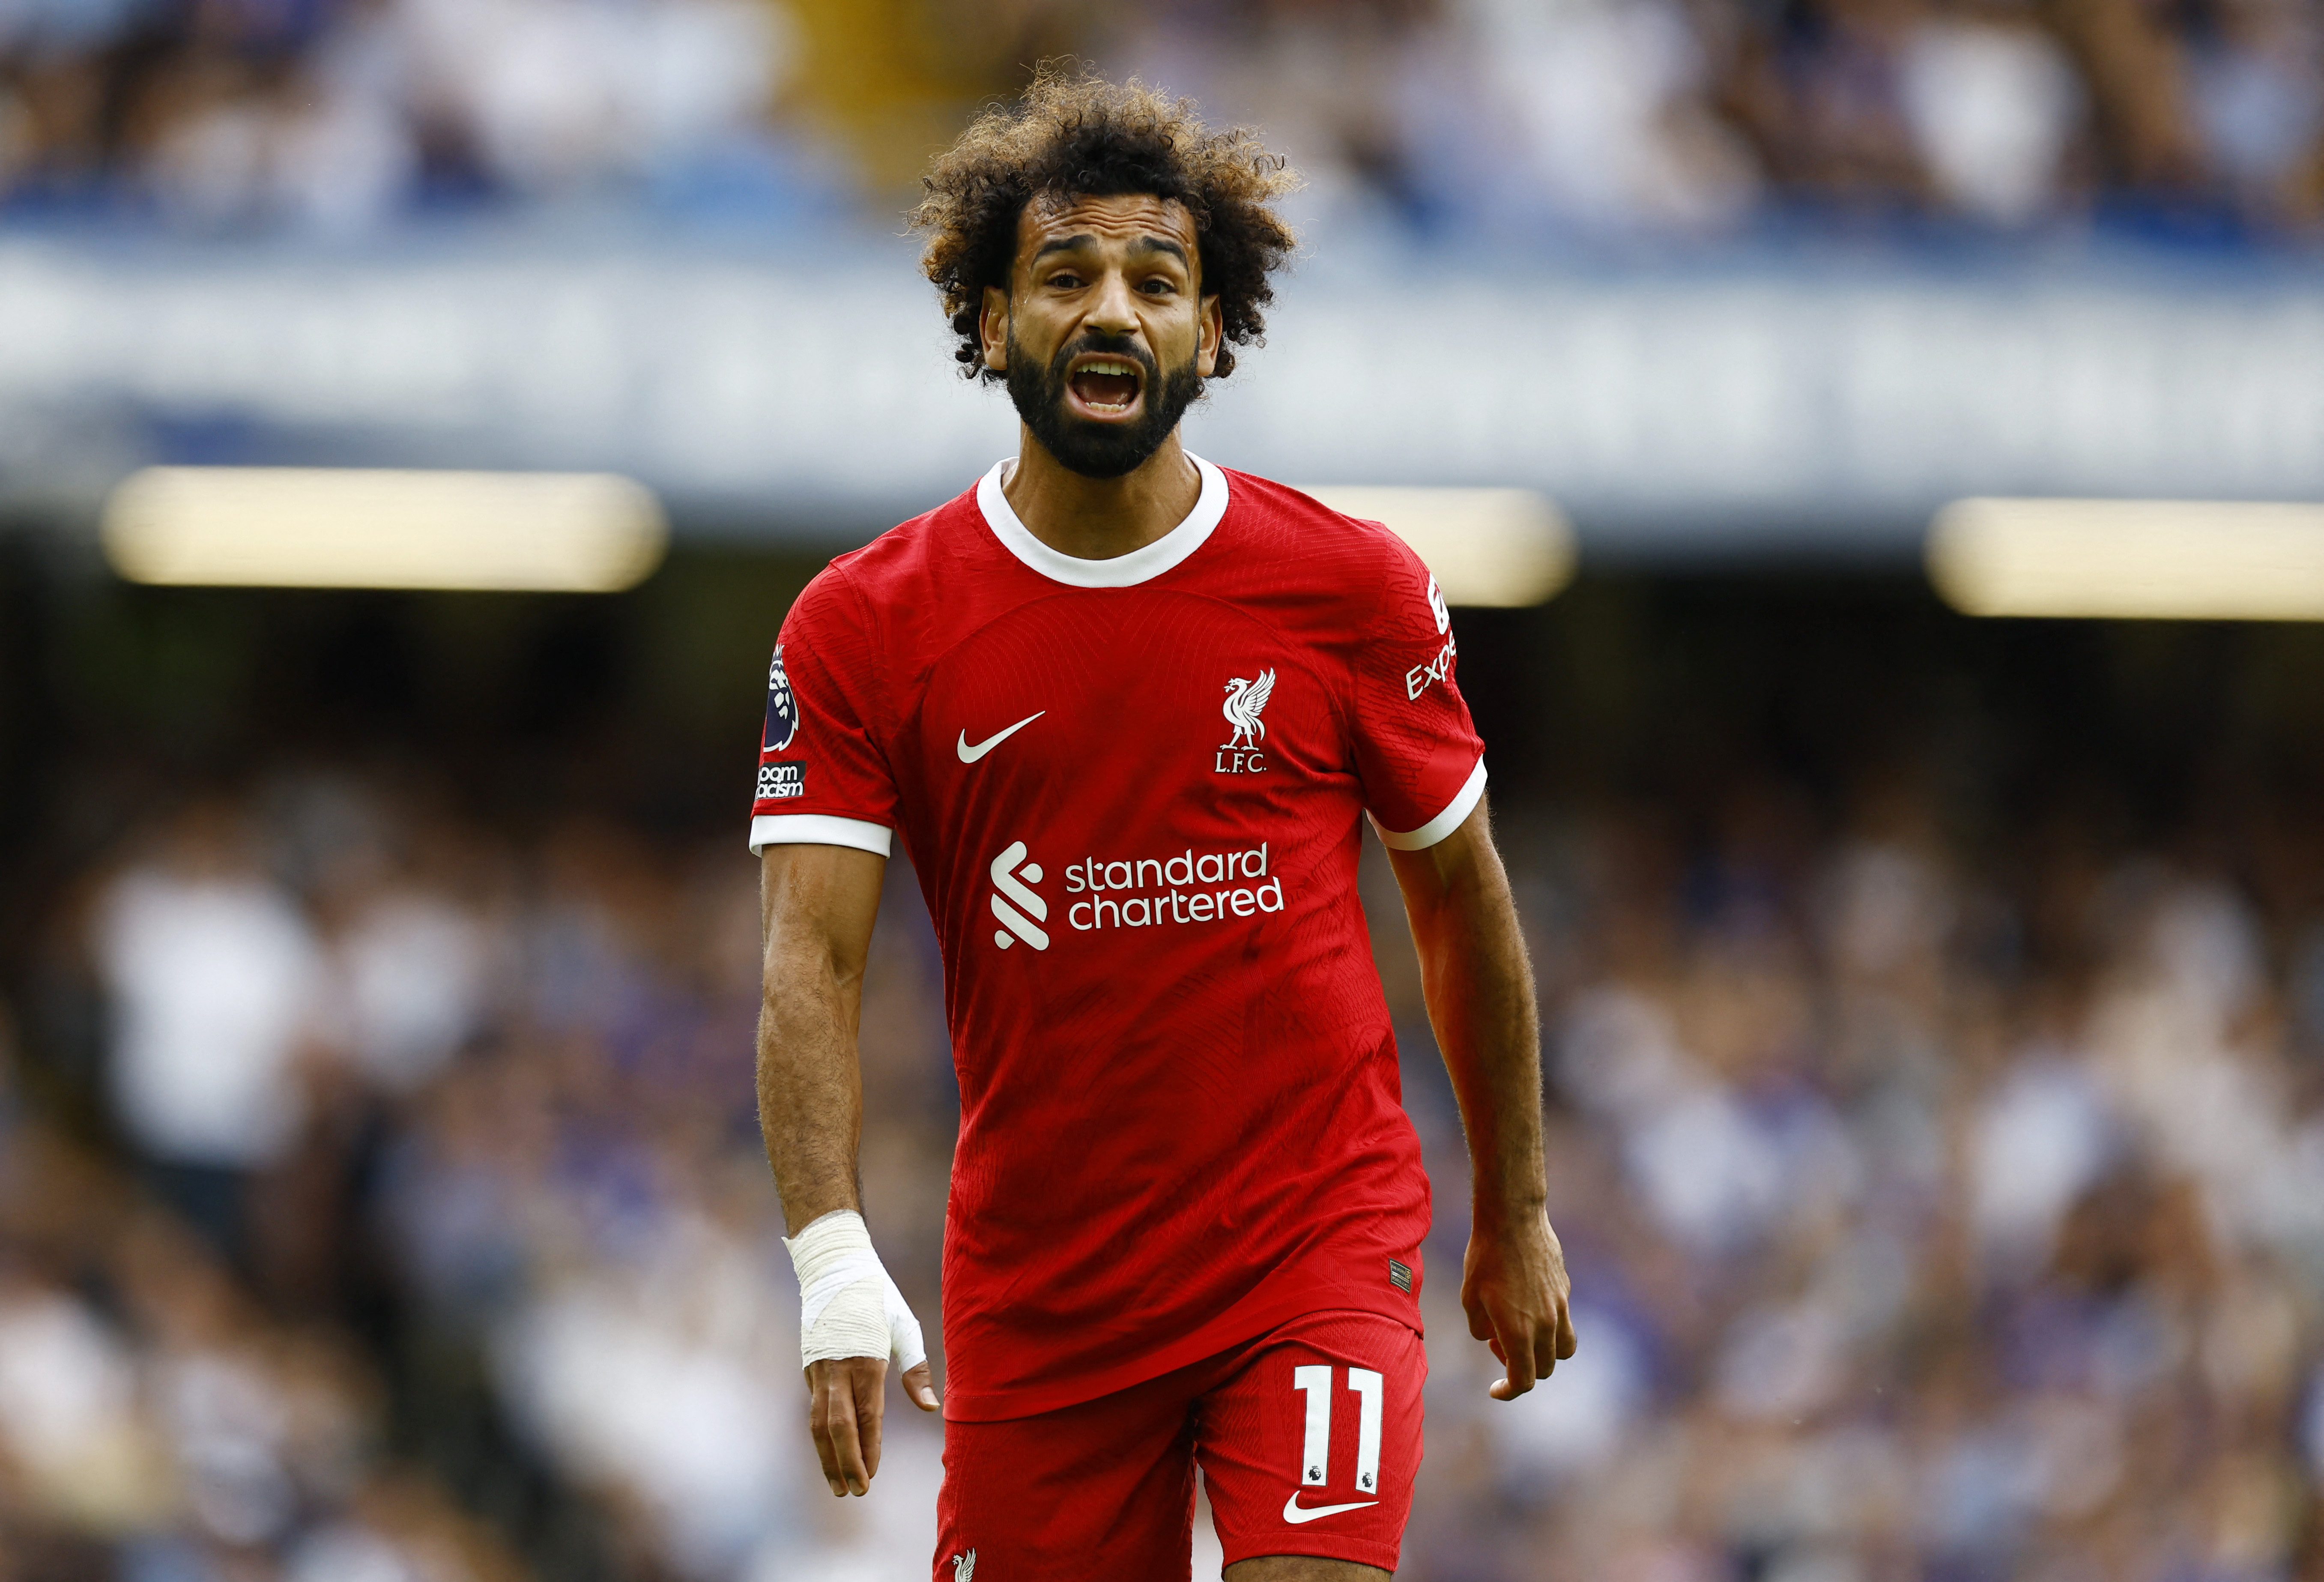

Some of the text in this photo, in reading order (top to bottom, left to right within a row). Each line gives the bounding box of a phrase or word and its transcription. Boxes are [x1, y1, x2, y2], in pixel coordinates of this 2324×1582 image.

[758, 766, 798, 783] oom
[1215, 752, 1267, 773] L.F.C.
[1066, 841, 1267, 893] standard
[1069, 876, 1284, 930] chartered
[1293, 1365, 1383, 1495] 11
